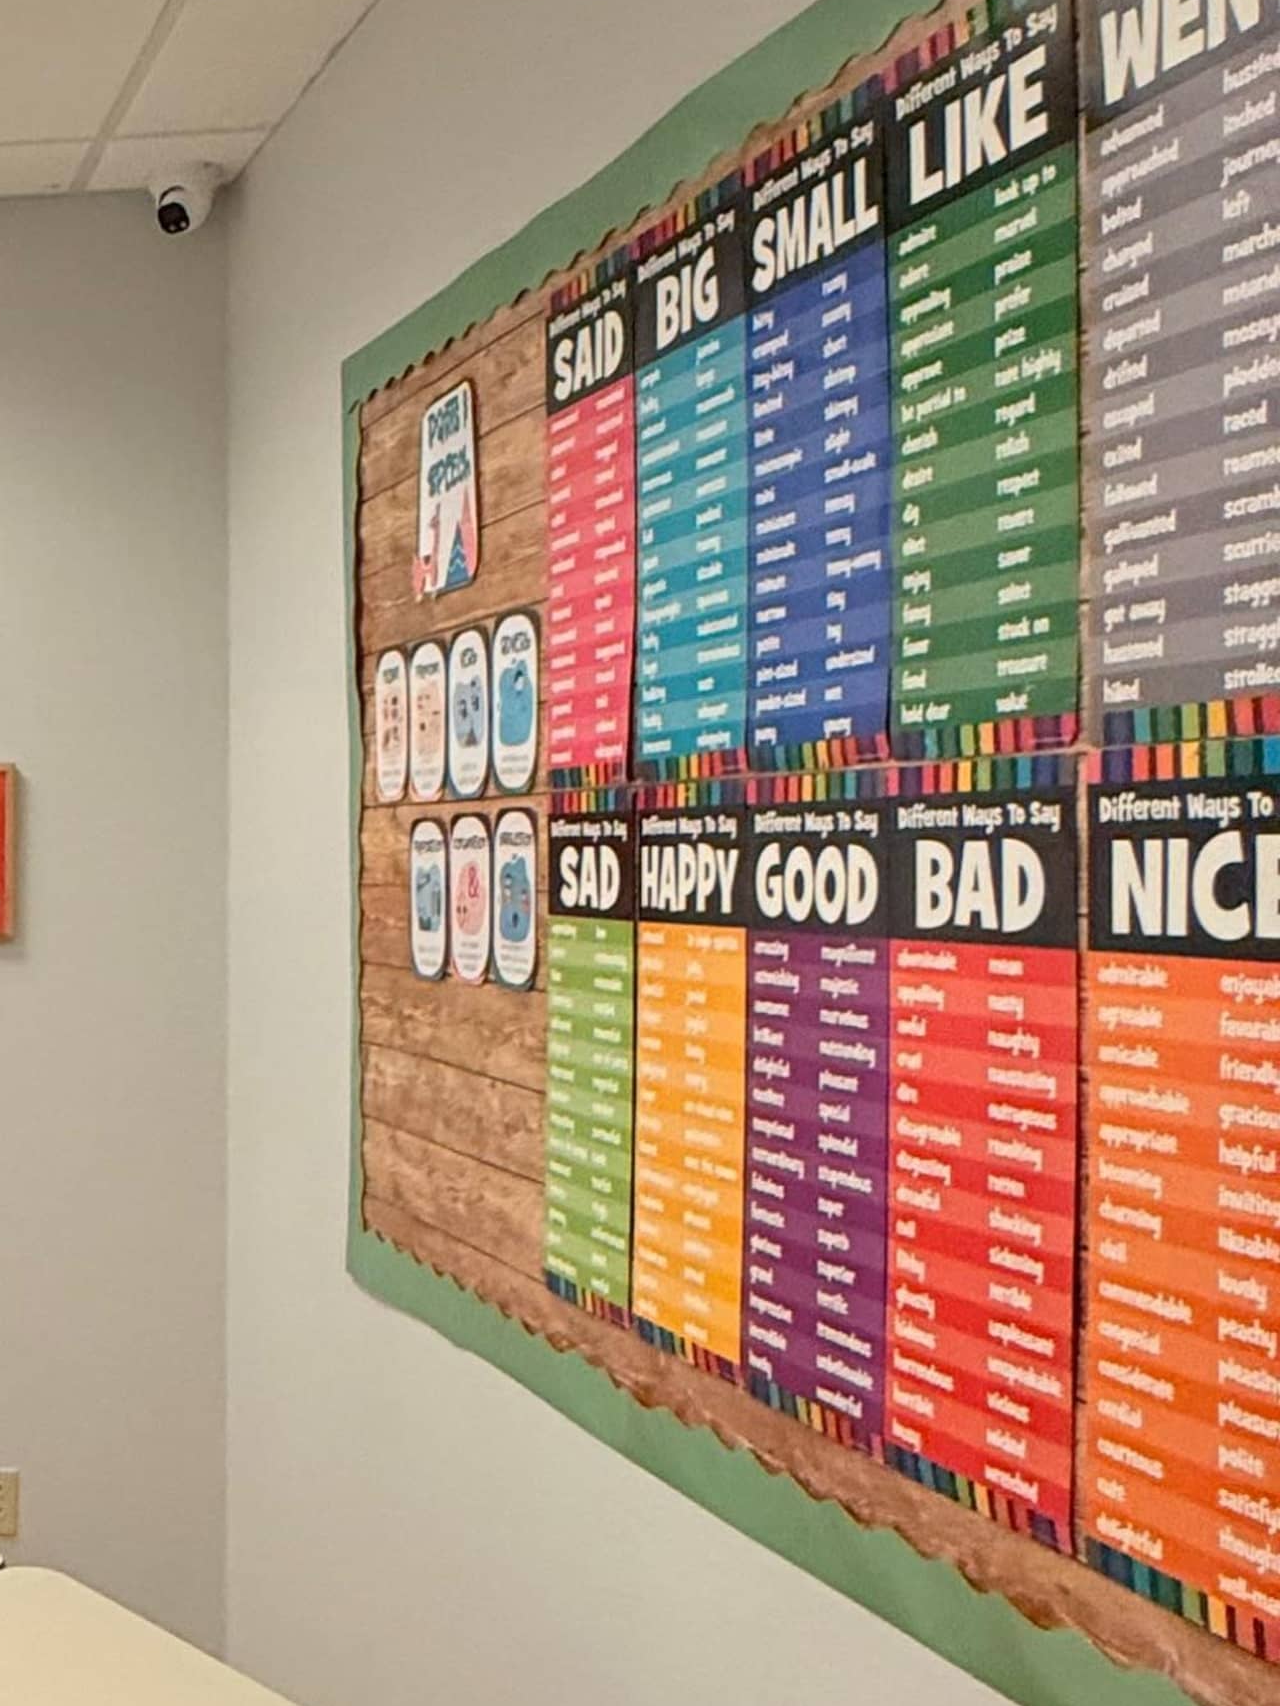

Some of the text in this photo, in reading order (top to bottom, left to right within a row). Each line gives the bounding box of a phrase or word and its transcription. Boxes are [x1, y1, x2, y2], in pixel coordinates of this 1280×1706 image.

[895, 3, 1057, 122] Different Ways To Say
[909, 44, 1048, 205] LIKE
[753, 120, 874, 212] Different Ways To Say
[752, 156, 879, 293] SMALL
[1223, 189, 1250, 220] left
[656, 245, 719, 351] BIG
[554, 310, 624, 401] SAID
[1224, 400, 1267, 432] raced
[754, 809, 879, 838] Different Ways To Say
[897, 800, 1062, 835] Different Ways To Say
[1098, 792, 1274, 828] Different Ways To
[559, 844, 620, 911] SAD
[640, 842, 740, 914] HAPPY
[755, 842, 878, 925] GOOD
[915, 838, 1046, 933] BAD
[1219, 1139, 1277, 1174] helpful
[1219, 1272, 1266, 1310] lovely
[1218, 1317, 1277, 1358] peachy
